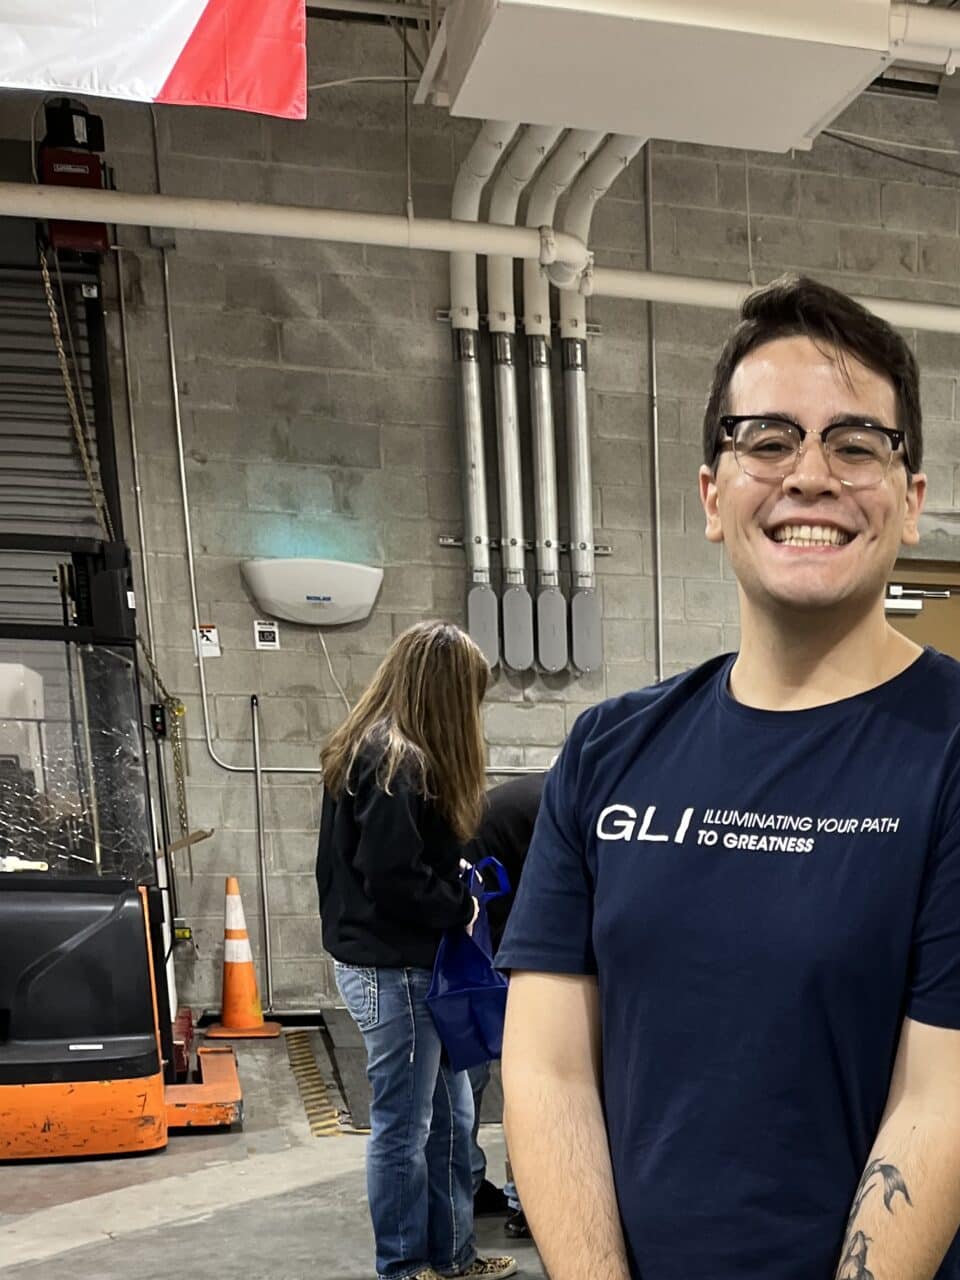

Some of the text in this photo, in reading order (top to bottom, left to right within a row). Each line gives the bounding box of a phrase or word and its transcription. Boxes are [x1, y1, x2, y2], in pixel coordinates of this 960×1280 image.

[596, 804, 694, 844] GLI
[703, 808, 899, 833] ILLUMINATING YOUR PATH
[697, 830, 814, 853] TO GREATNESS
